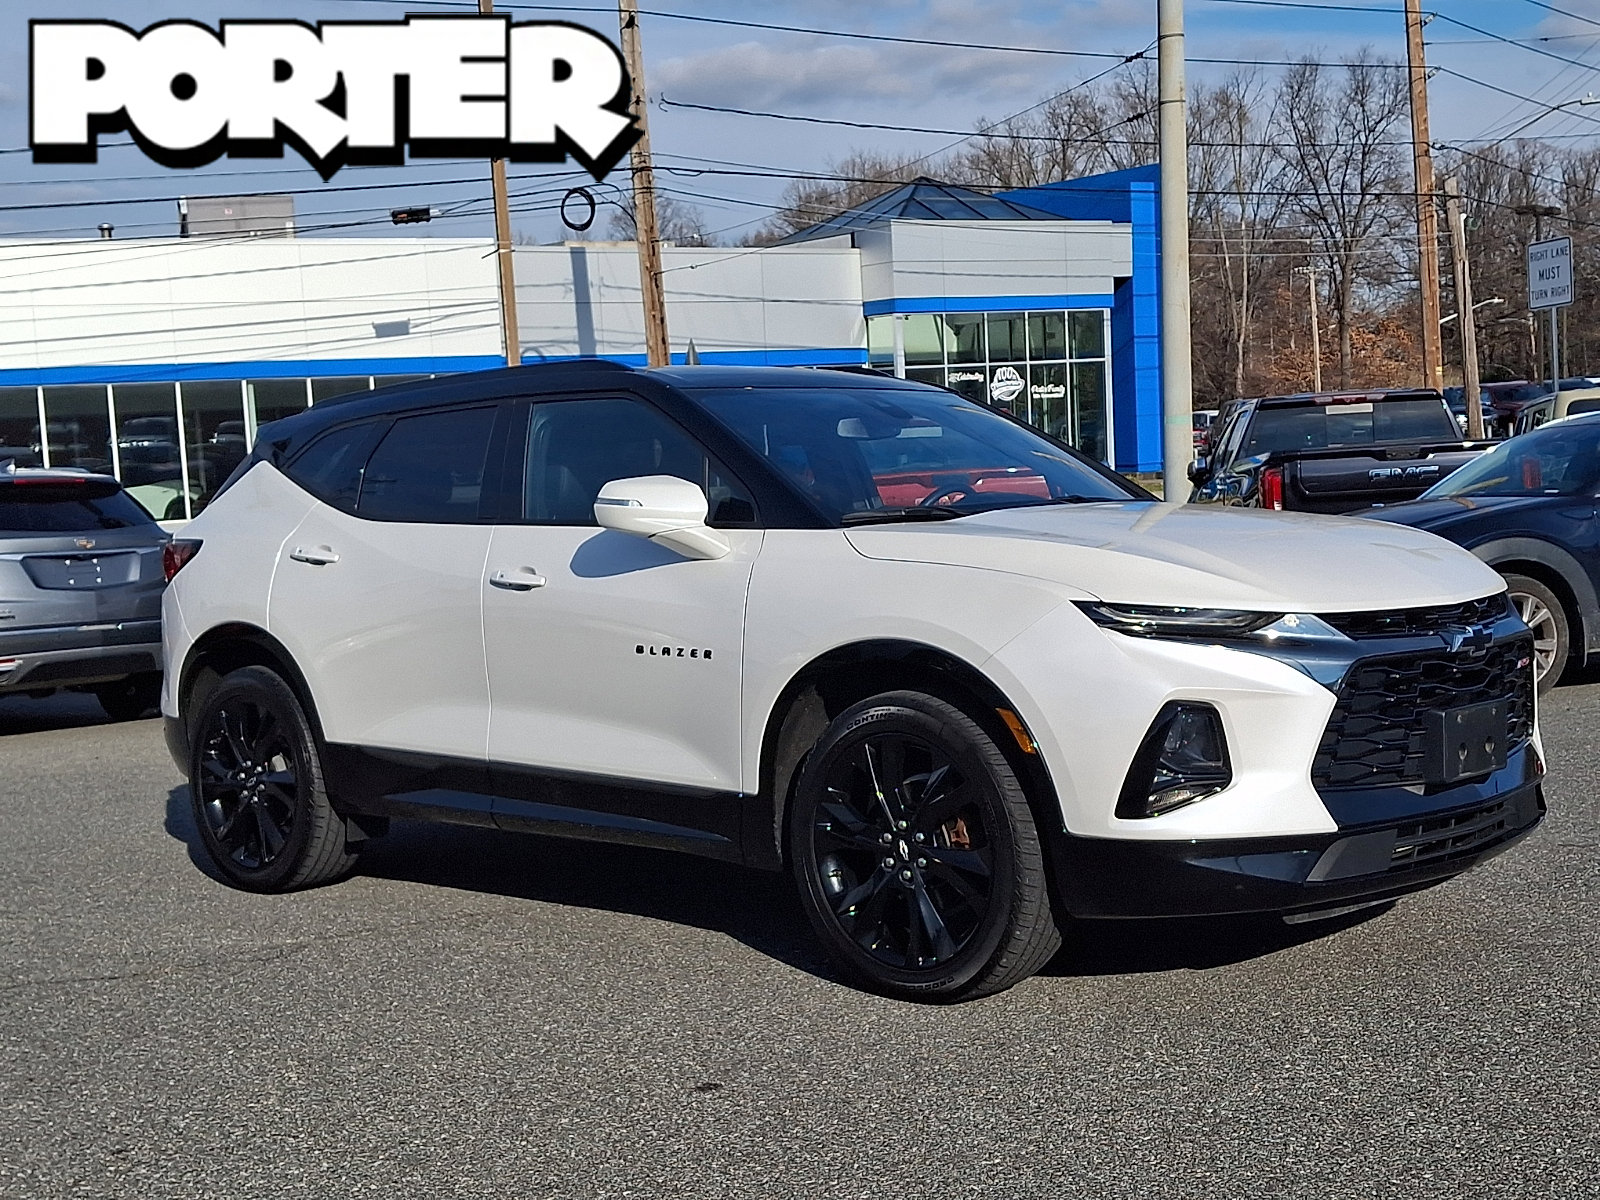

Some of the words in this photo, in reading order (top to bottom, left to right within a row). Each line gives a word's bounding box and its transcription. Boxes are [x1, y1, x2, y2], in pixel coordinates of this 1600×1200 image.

[1529, 249, 1548, 262] RIGHT
[1551, 245, 1569, 258] LANE
[1538, 265, 1561, 281] MUST
[1531, 289, 1548, 301] TURN
[1550, 285, 1569, 298] RIGHT
[1368, 465, 1440, 482] GMC
[635, 644, 713, 660] BLAZER
